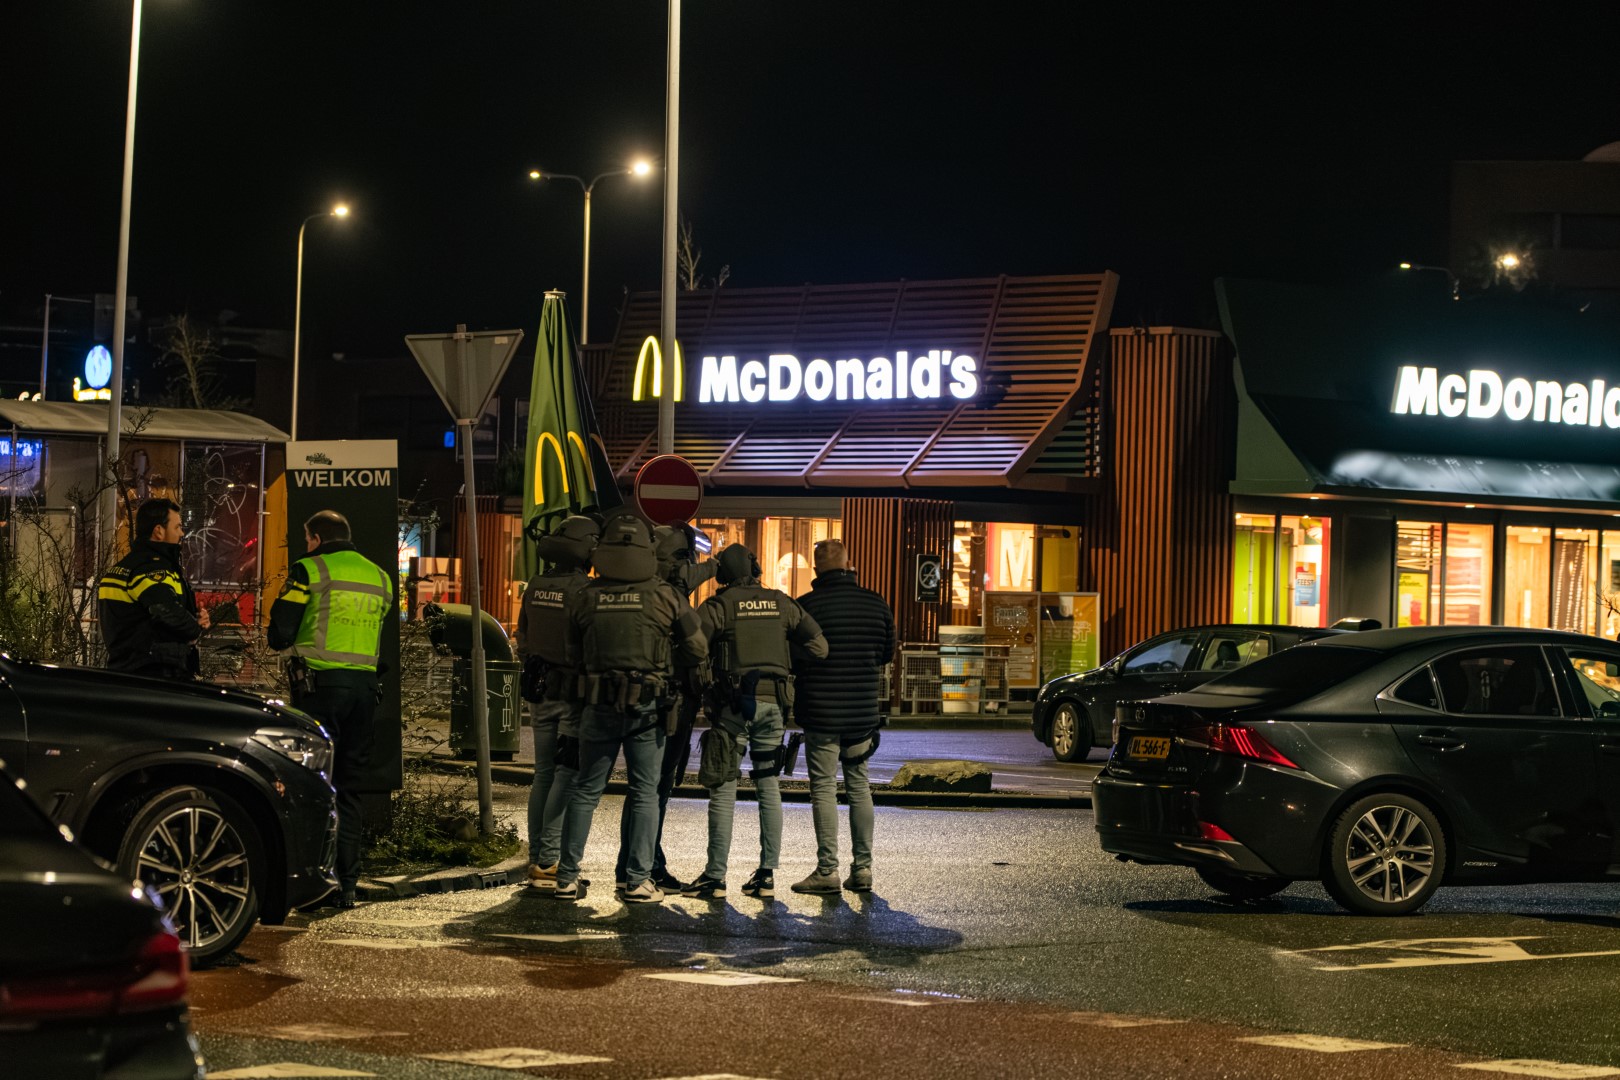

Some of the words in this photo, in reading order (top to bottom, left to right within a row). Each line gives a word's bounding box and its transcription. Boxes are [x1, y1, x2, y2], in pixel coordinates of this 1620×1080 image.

[699, 349, 978, 403] McDonald's
[294, 469, 391, 488] WELKOM
[534, 590, 564, 602] POLITIE
[738, 600, 777, 610] POLITIE
